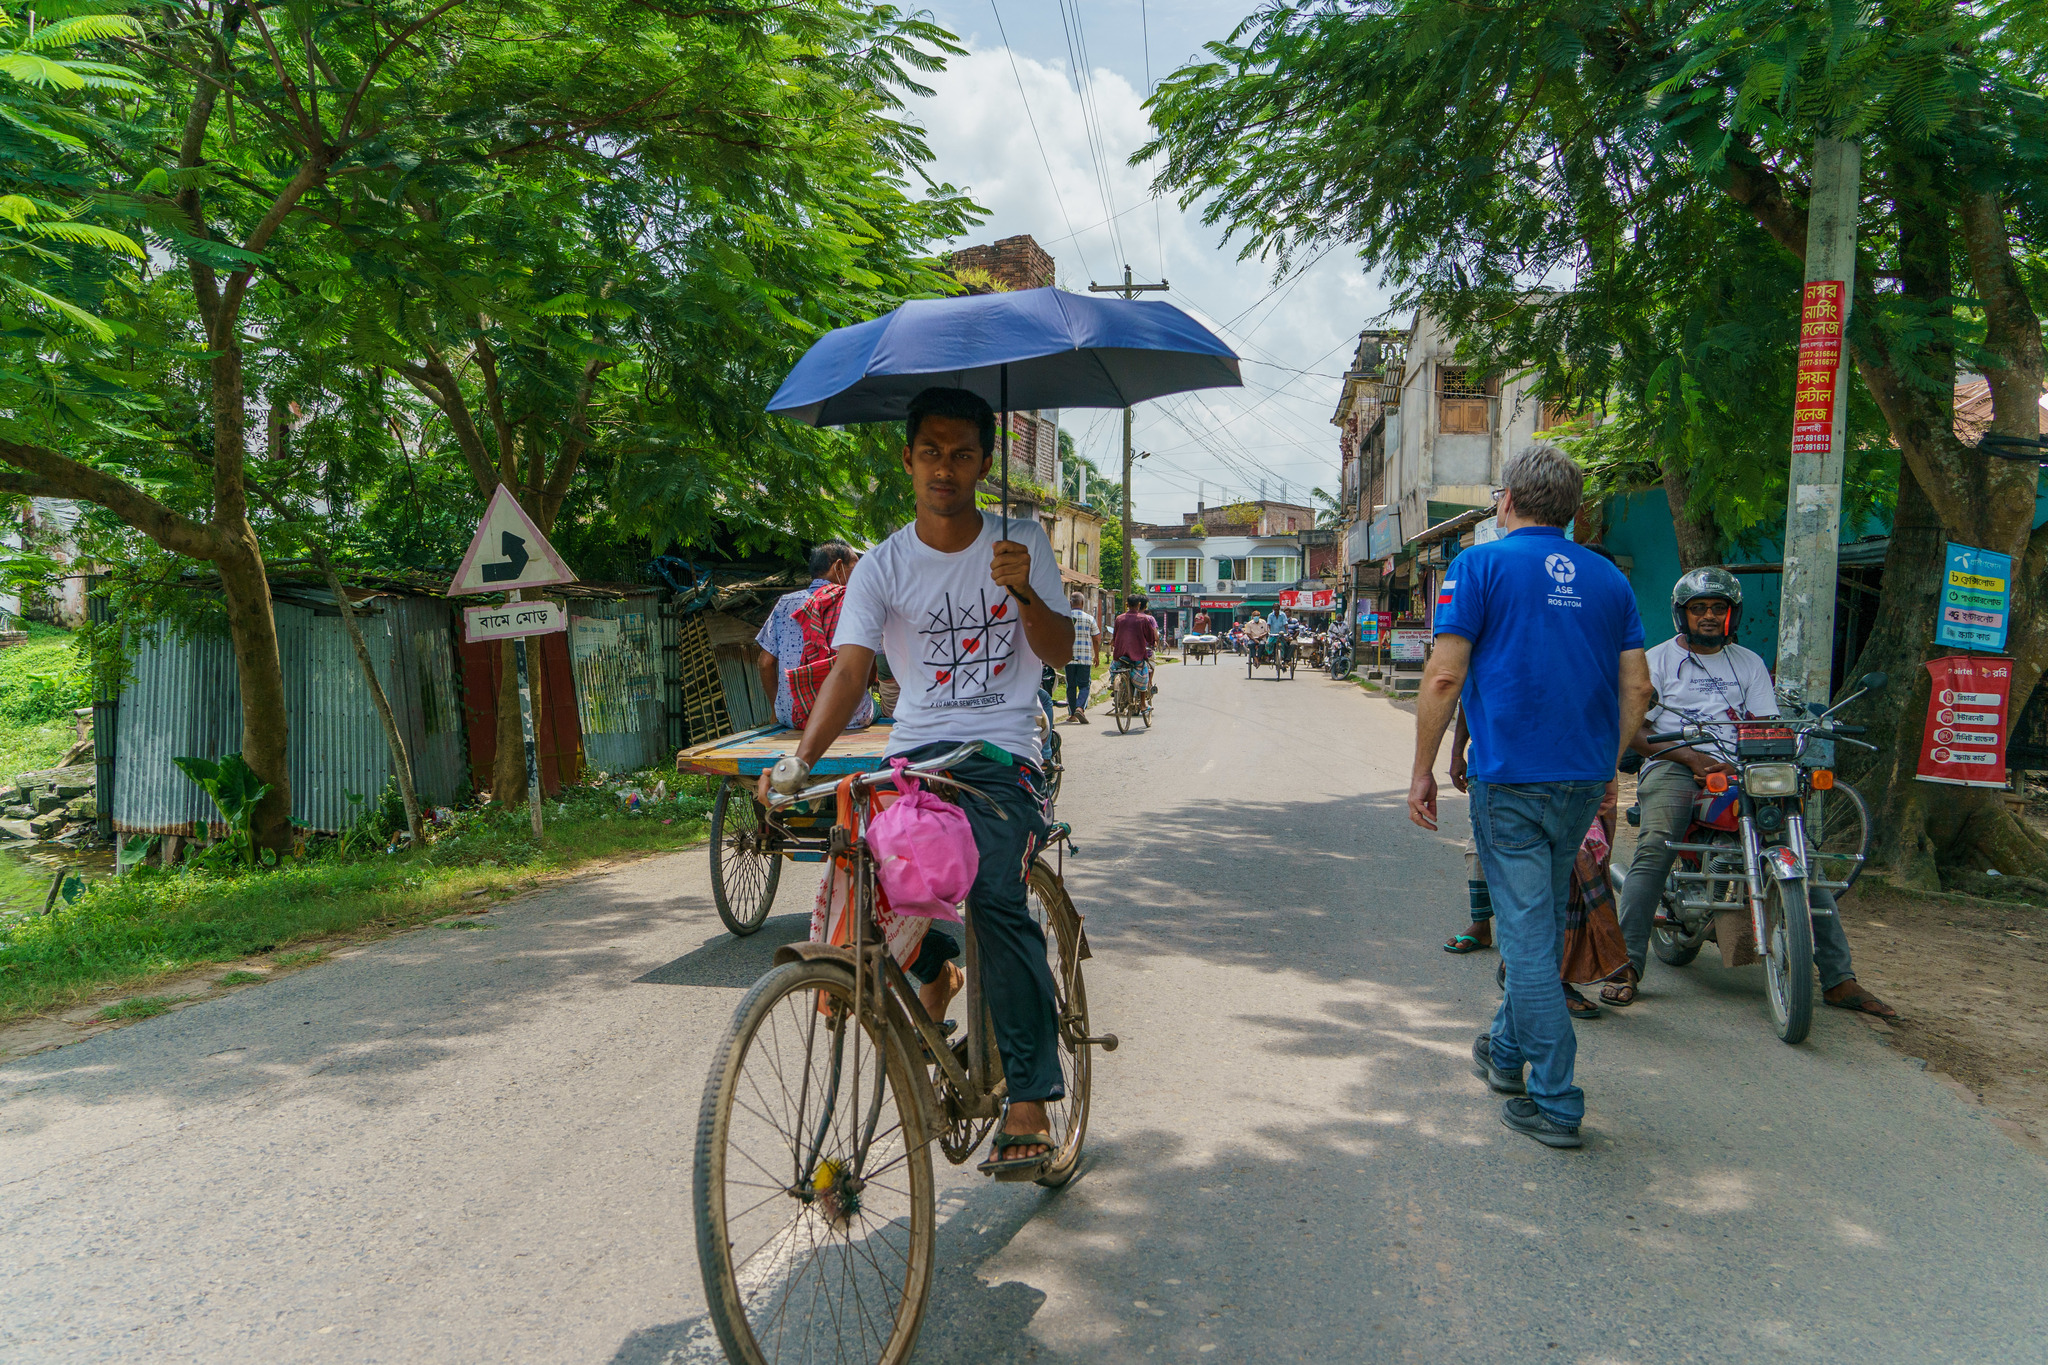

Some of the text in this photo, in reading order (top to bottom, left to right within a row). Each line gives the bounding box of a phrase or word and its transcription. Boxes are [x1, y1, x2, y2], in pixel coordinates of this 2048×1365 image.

[1807, 285, 1838, 299] নগর
[1805, 300, 1837, 320] নার্সিং
[1802, 322, 1840, 336] কলেজ
[1798, 369, 1830, 385] উদয়ন
[1795, 387, 1832, 403] ডেন্টাল
[1795, 409, 1828, 421] কলেজ
[1555, 585, 1574, 594] ASE
[478, 610, 548, 628] বামে মোড়
[1992, 668, 2008, 678] রবি
[959, 698, 980, 707] SEMPRE
[980, 696, 996, 704] VENCE
